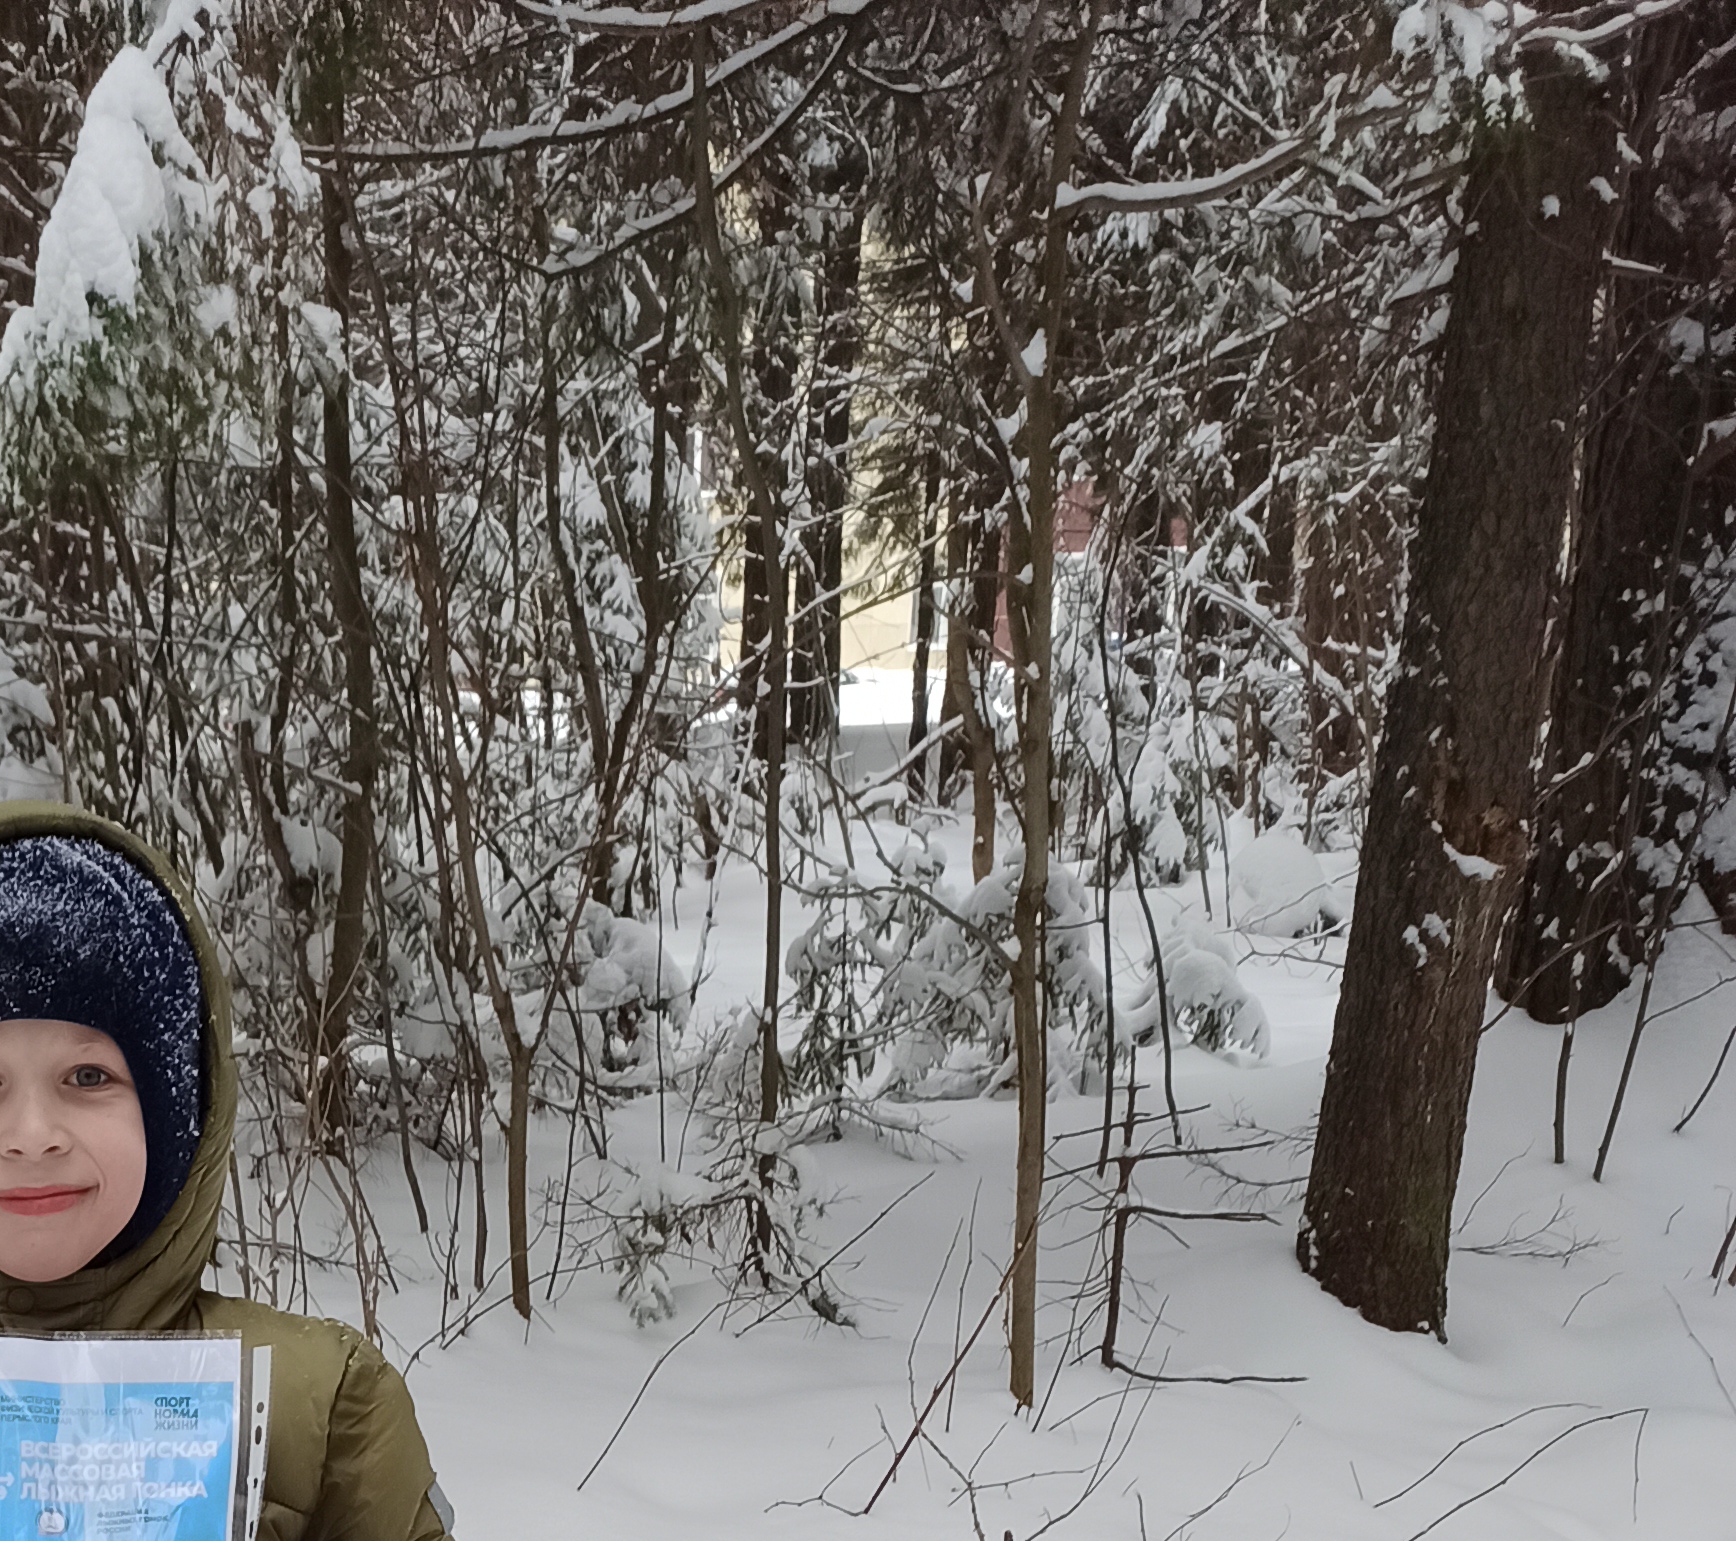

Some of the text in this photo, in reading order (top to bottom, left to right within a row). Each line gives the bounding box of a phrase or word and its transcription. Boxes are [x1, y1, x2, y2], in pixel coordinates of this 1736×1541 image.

[155, 1396, 191, 1408] СПОРТ
[155, 1408, 199, 1419] НОРМА
[154, 1419, 198, 1431] ЖИЗНИ
[20, 1437, 218, 1460] ВСЕРОССИЙСКАЯ
[20, 1461, 145, 1481] МАССОВАЯ
[20, 1482, 125, 1502] ЛЫЖНАЯ
